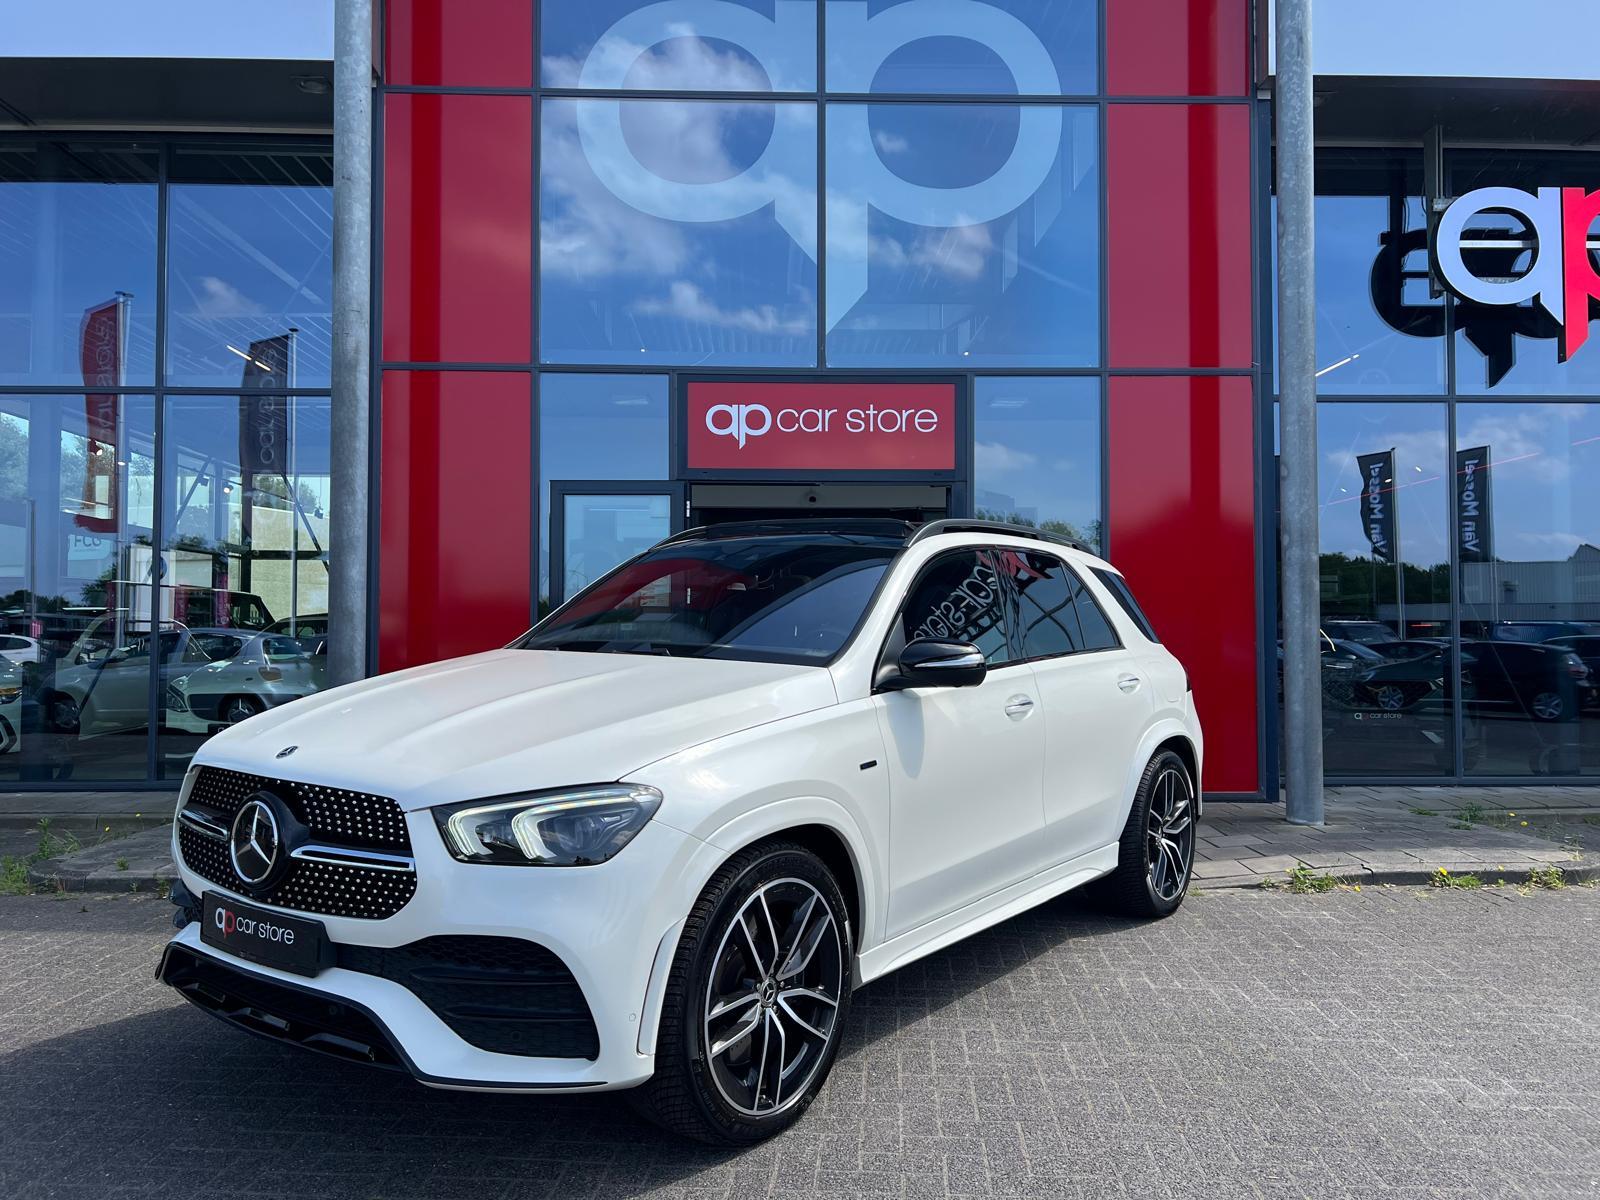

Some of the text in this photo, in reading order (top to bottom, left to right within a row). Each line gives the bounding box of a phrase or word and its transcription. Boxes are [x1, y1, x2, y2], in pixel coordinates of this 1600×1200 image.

[577, 0, 1062, 335] ap
[705, 403, 938, 449] ap car store
[215, 907, 295, 945] ap car store
